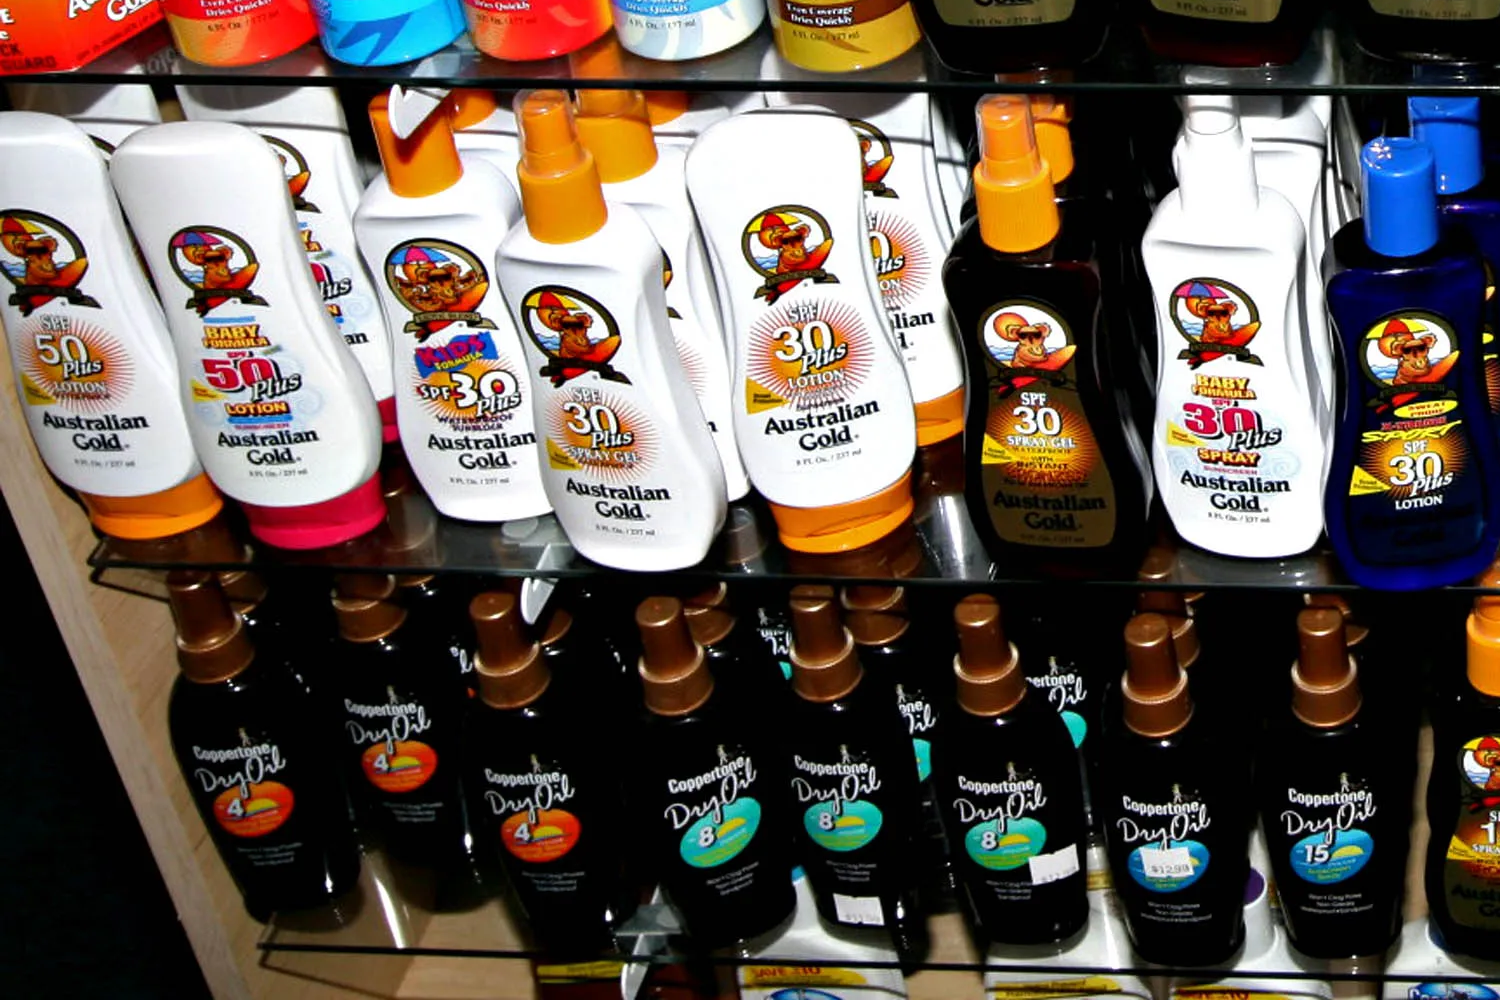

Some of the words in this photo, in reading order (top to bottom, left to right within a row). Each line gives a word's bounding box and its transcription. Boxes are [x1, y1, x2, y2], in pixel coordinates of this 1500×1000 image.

[788, 306, 819, 324] SPF
[203, 324, 260, 339] BABY
[772, 320, 835, 363] 30
[34, 334, 88, 366] 50
[802, 342, 847, 377] Plus
[201, 357, 278, 392] 50
[54, 382, 108, 394] LOTION
[251, 373, 301, 401] Plus
[226, 402, 290, 417] LOTION
[1012, 406, 1061, 436] 30
[218, 427, 320, 449] Australian
[247, 449, 295, 467] Gold
[1199, 448, 1261, 466] SPRAY
[1388, 452, 1443, 486] 30
[1395, 495, 1443, 511] LOTION
[668, 756, 744, 794] Coppertone
[1288, 787, 1366, 807] Coppertone
[698, 824, 715, 847] 8
[1303, 844, 1329, 863] 15
